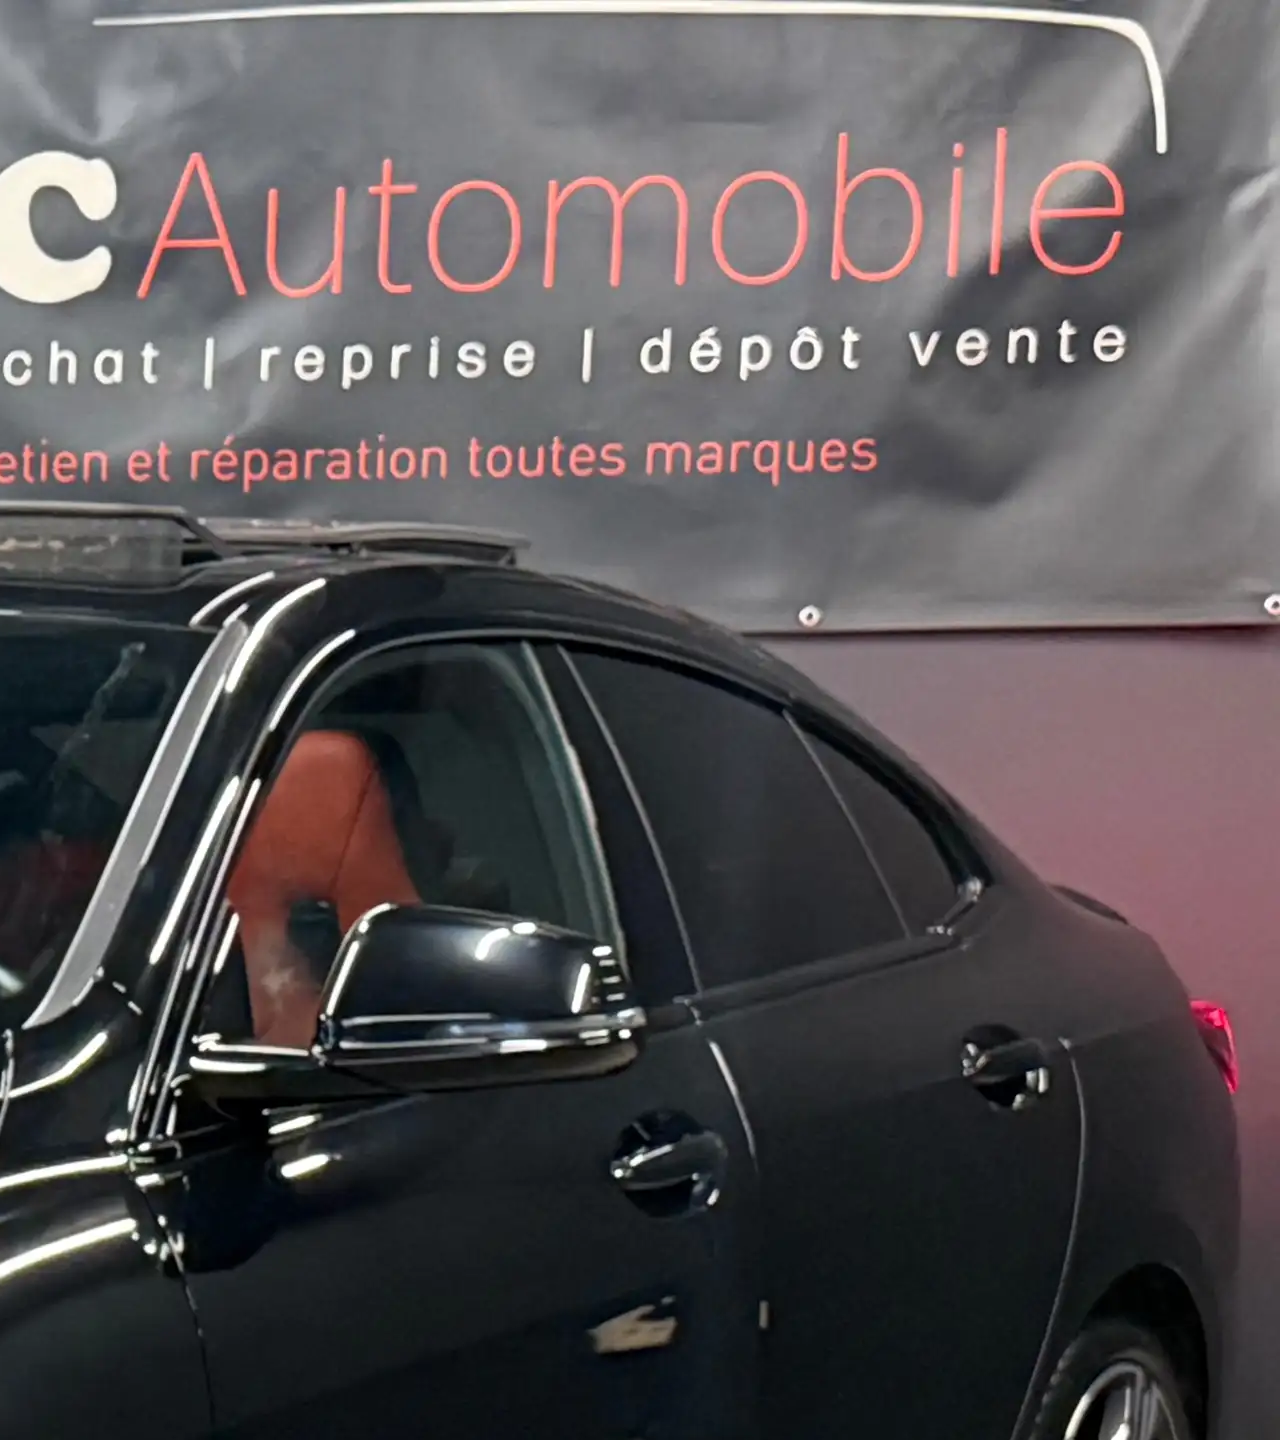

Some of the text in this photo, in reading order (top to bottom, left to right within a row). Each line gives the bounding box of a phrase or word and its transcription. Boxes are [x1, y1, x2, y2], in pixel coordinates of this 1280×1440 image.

[136, 127, 1126, 301] Automobile
[258, 336, 537, 390] reprise
[639, 326, 861, 382] dépôt
[908, 318, 1129, 368] vente
[127, 441, 171, 484] et
[190, 436, 448, 492] réparation
[469, 437, 627, 480] toutes
[645, 436, 879, 487] marques
